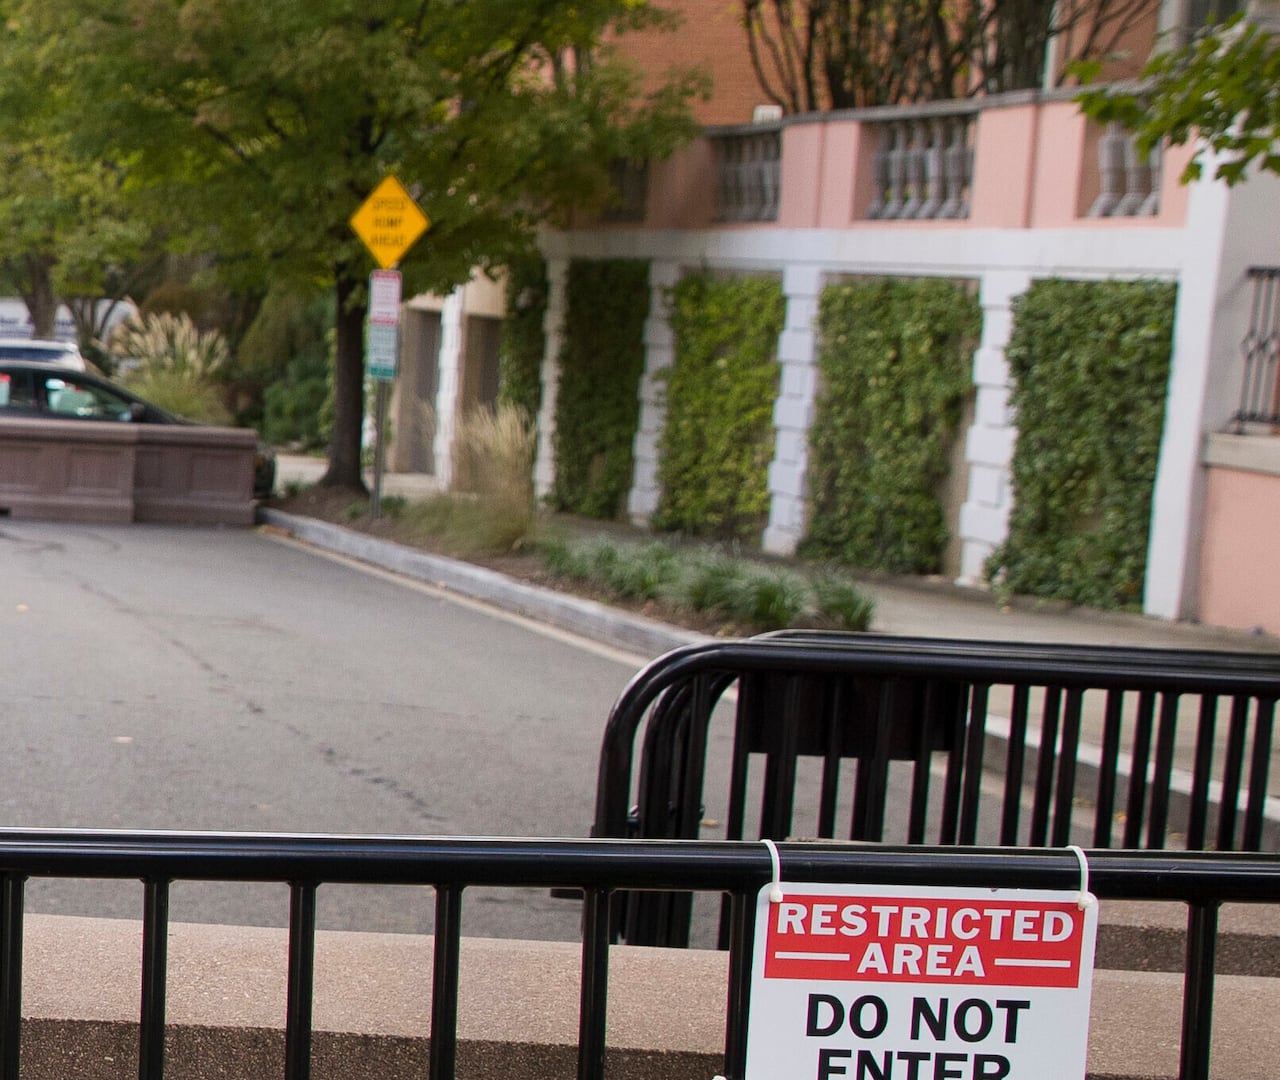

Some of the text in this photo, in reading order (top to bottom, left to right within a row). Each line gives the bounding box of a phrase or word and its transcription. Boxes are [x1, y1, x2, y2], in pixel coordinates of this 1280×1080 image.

[777, 902, 1074, 942] RESTRICTED
[857, 942, 985, 977] AREA
[806, 993, 1031, 1044] DO NOT
